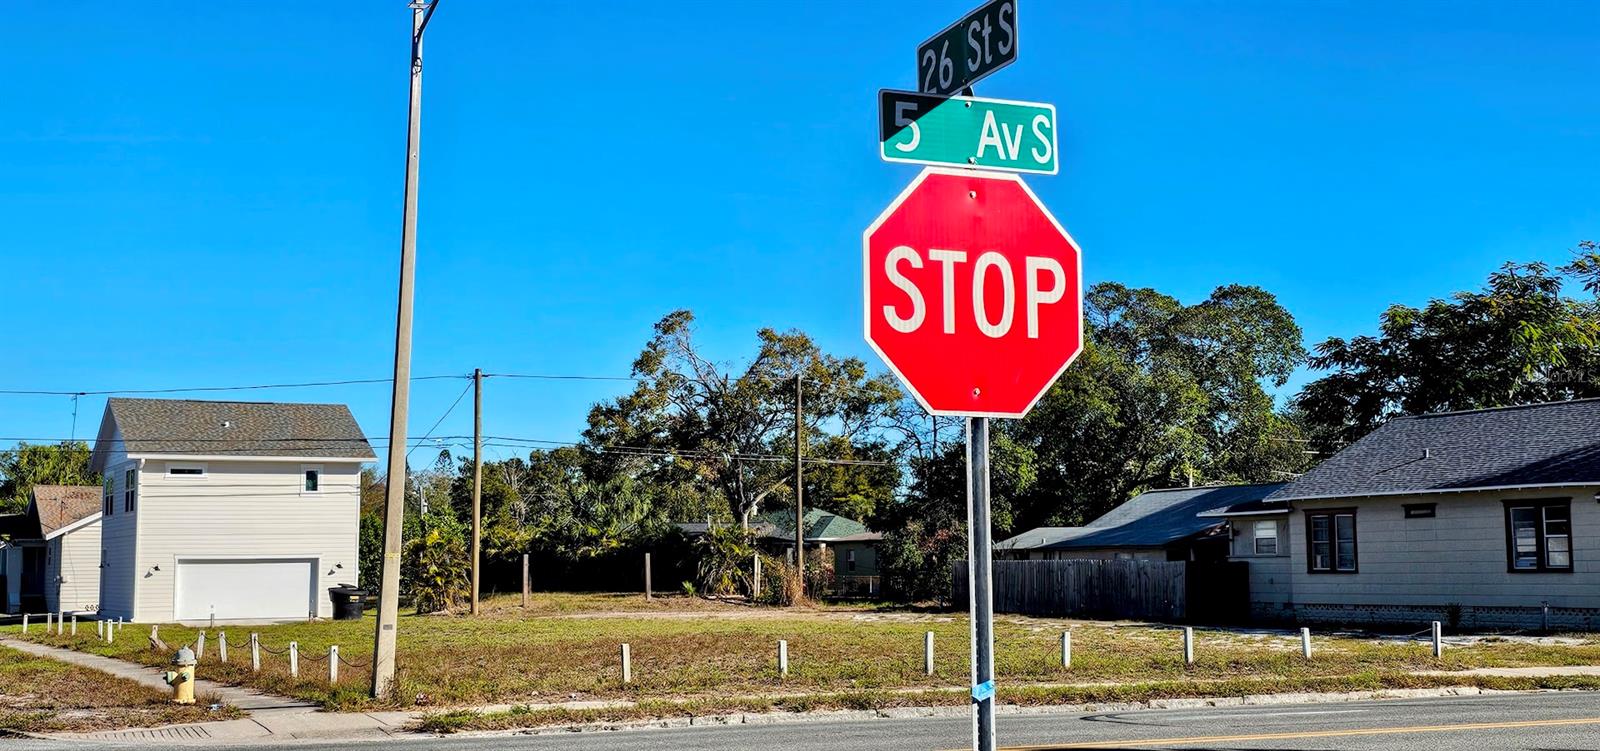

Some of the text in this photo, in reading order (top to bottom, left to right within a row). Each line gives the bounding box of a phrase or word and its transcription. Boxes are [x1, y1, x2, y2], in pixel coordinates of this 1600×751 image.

[922, 2, 1014, 94] 26 St S
[895, 101, 1053, 164] 5 Av S
[882, 245, 1067, 339] STOP
